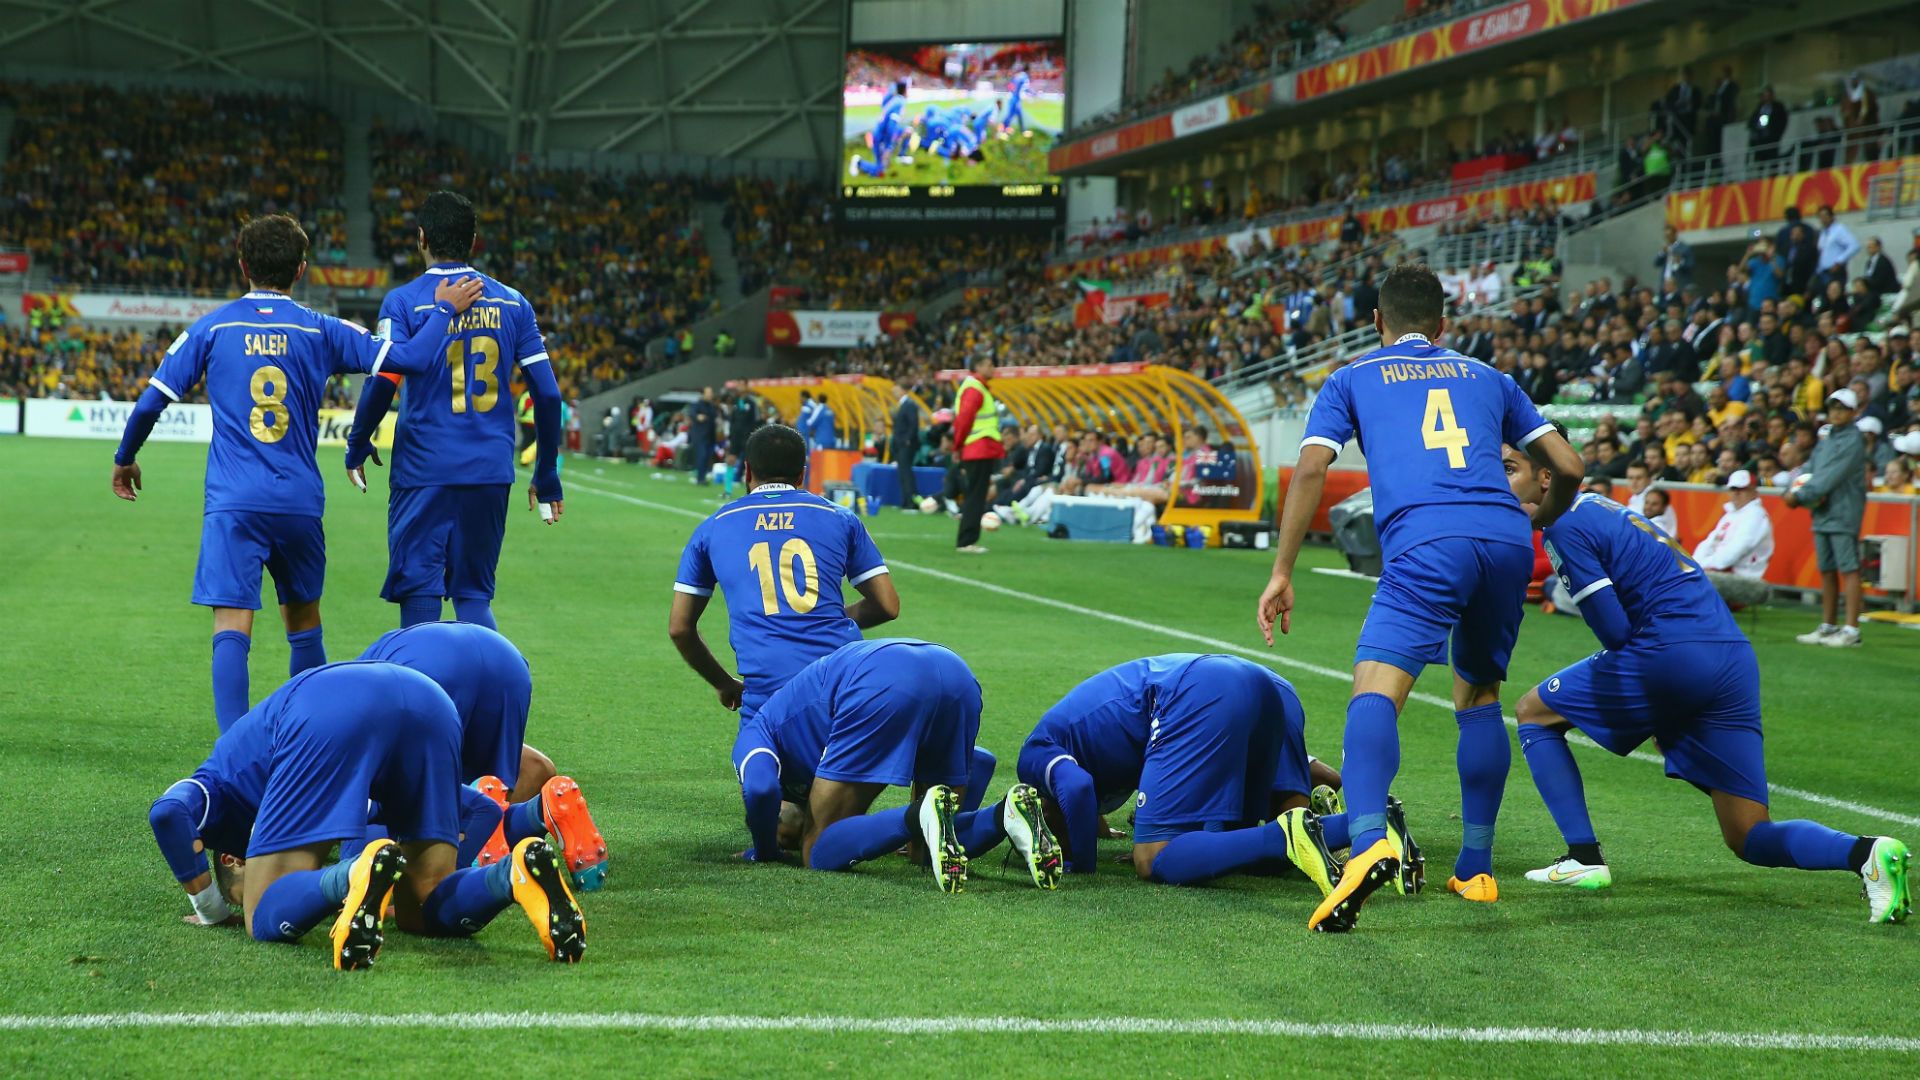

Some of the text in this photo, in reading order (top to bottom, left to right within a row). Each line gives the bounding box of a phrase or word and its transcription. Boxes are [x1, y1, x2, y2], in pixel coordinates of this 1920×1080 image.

[107, 297, 182, 316] Australia
[244, 333, 288, 356] SALEH
[1399, 333, 1427, 343] KUWAI
[446, 335, 499, 414] 13
[1380, 362, 1477, 384] HUSSAIN F.
[249, 365, 289, 443] 8
[90, 407, 196, 425] HYDAI
[1421, 388, 1470, 469] 4
[1192, 483, 1240, 496] Australia
[754, 512, 795, 531] AZIZ
[748, 537, 819, 616] 10
